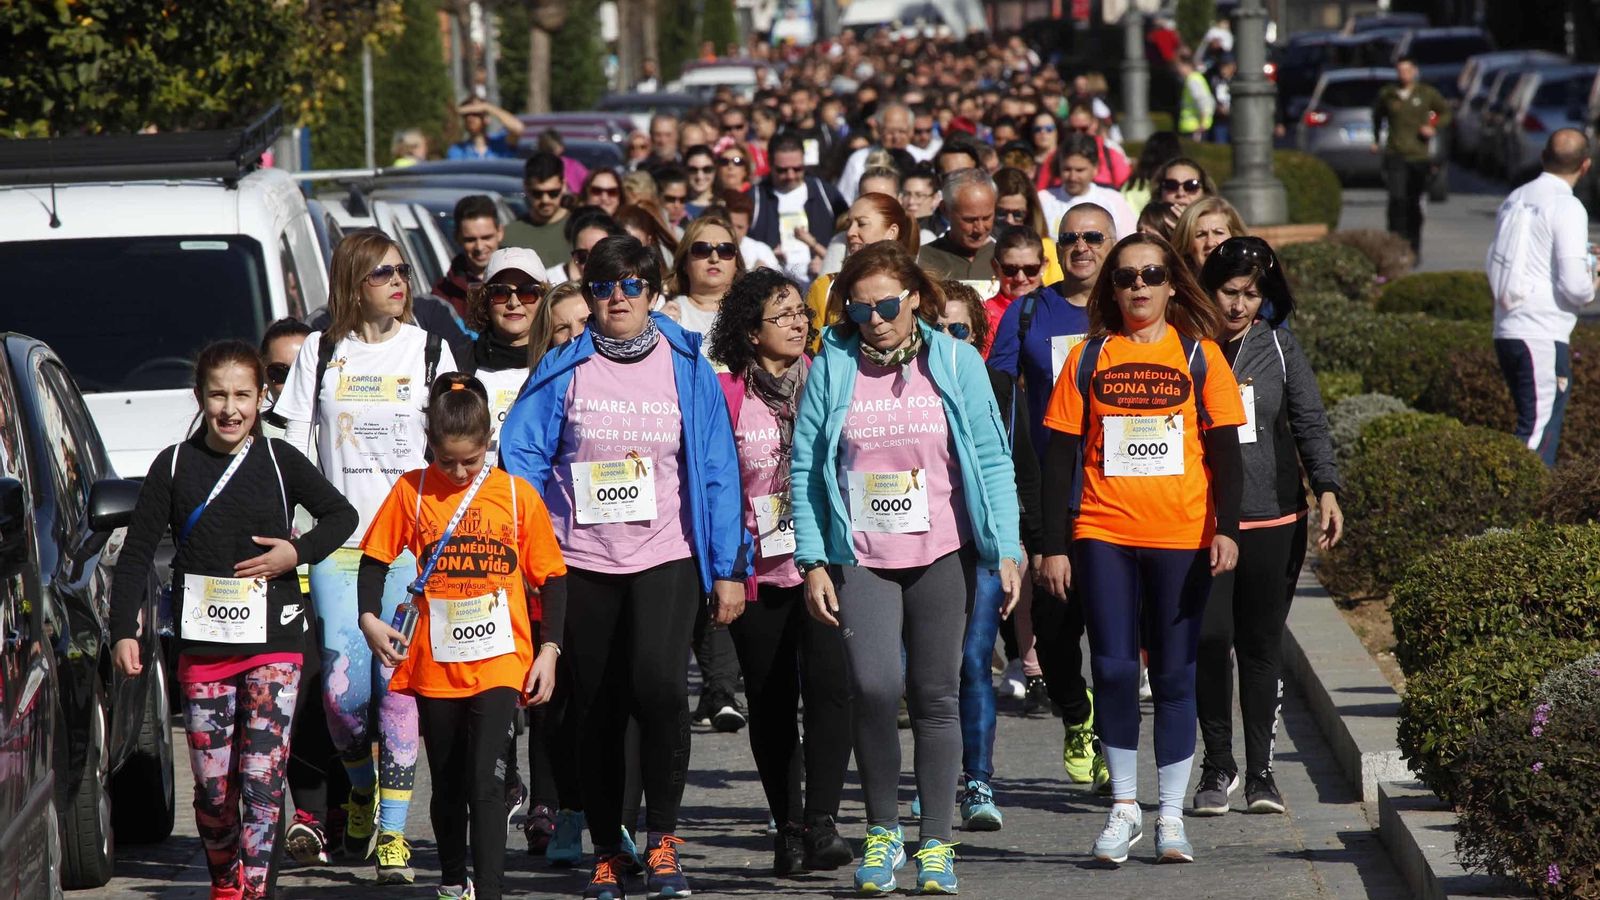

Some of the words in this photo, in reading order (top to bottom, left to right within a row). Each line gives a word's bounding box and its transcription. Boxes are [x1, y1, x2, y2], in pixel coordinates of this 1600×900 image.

[1104, 371, 1130, 380] dona
[1133, 370, 1181, 381] MÉDULA
[1103, 383, 1147, 394] DONA
[1151, 382, 1181, 396] vida
[586, 400, 637, 414] MAREA
[641, 402, 680, 415] ROSA
[851, 399, 901, 412] MAREA
[907, 396, 943, 408] ROSA
[583, 414, 678, 430] CONTRA
[848, 410, 945, 426] CONTRA
[623, 431, 638, 441] DE
[641, 432, 678, 443] MAMA
[844, 426, 886, 440] ANCER
[890, 425, 905, 436] DE
[908, 424, 945, 434] MAMA
[862, 442, 880, 450] ISLA
[883, 438, 920, 448] CRISTINA
[1128, 442, 1168, 456] 0000
[596, 486, 639, 502] 0000
[870, 498, 912, 512] 0000
[432, 544, 457, 554] dna
[460, 541, 506, 556] MÉDULA
[428, 556, 475, 571] ONA
[479, 554, 510, 574] vida
[207, 604, 250, 620] 0000
[452, 622, 496, 640] 0000
